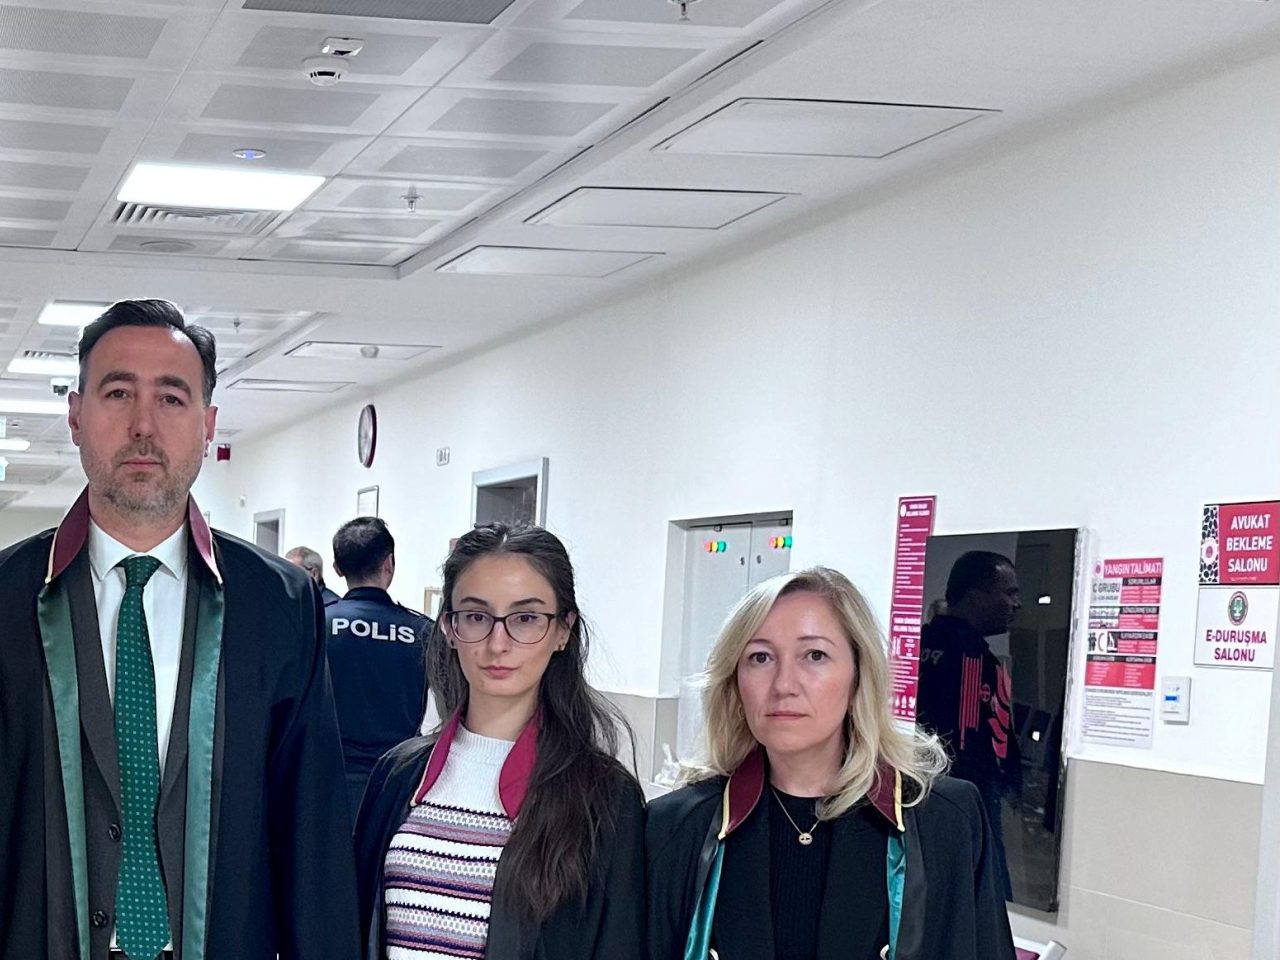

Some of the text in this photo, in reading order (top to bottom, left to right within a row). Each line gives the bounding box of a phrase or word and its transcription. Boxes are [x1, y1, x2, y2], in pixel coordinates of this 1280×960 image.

[1230, 514, 1271, 530] AVUKAT
[1226, 535, 1274, 552] BEKLEME
[1227, 557, 1269, 573] SALONU
[1205, 629, 1268, 647] E-DURUŞMA
[1214, 647, 1256, 662] SALONU
